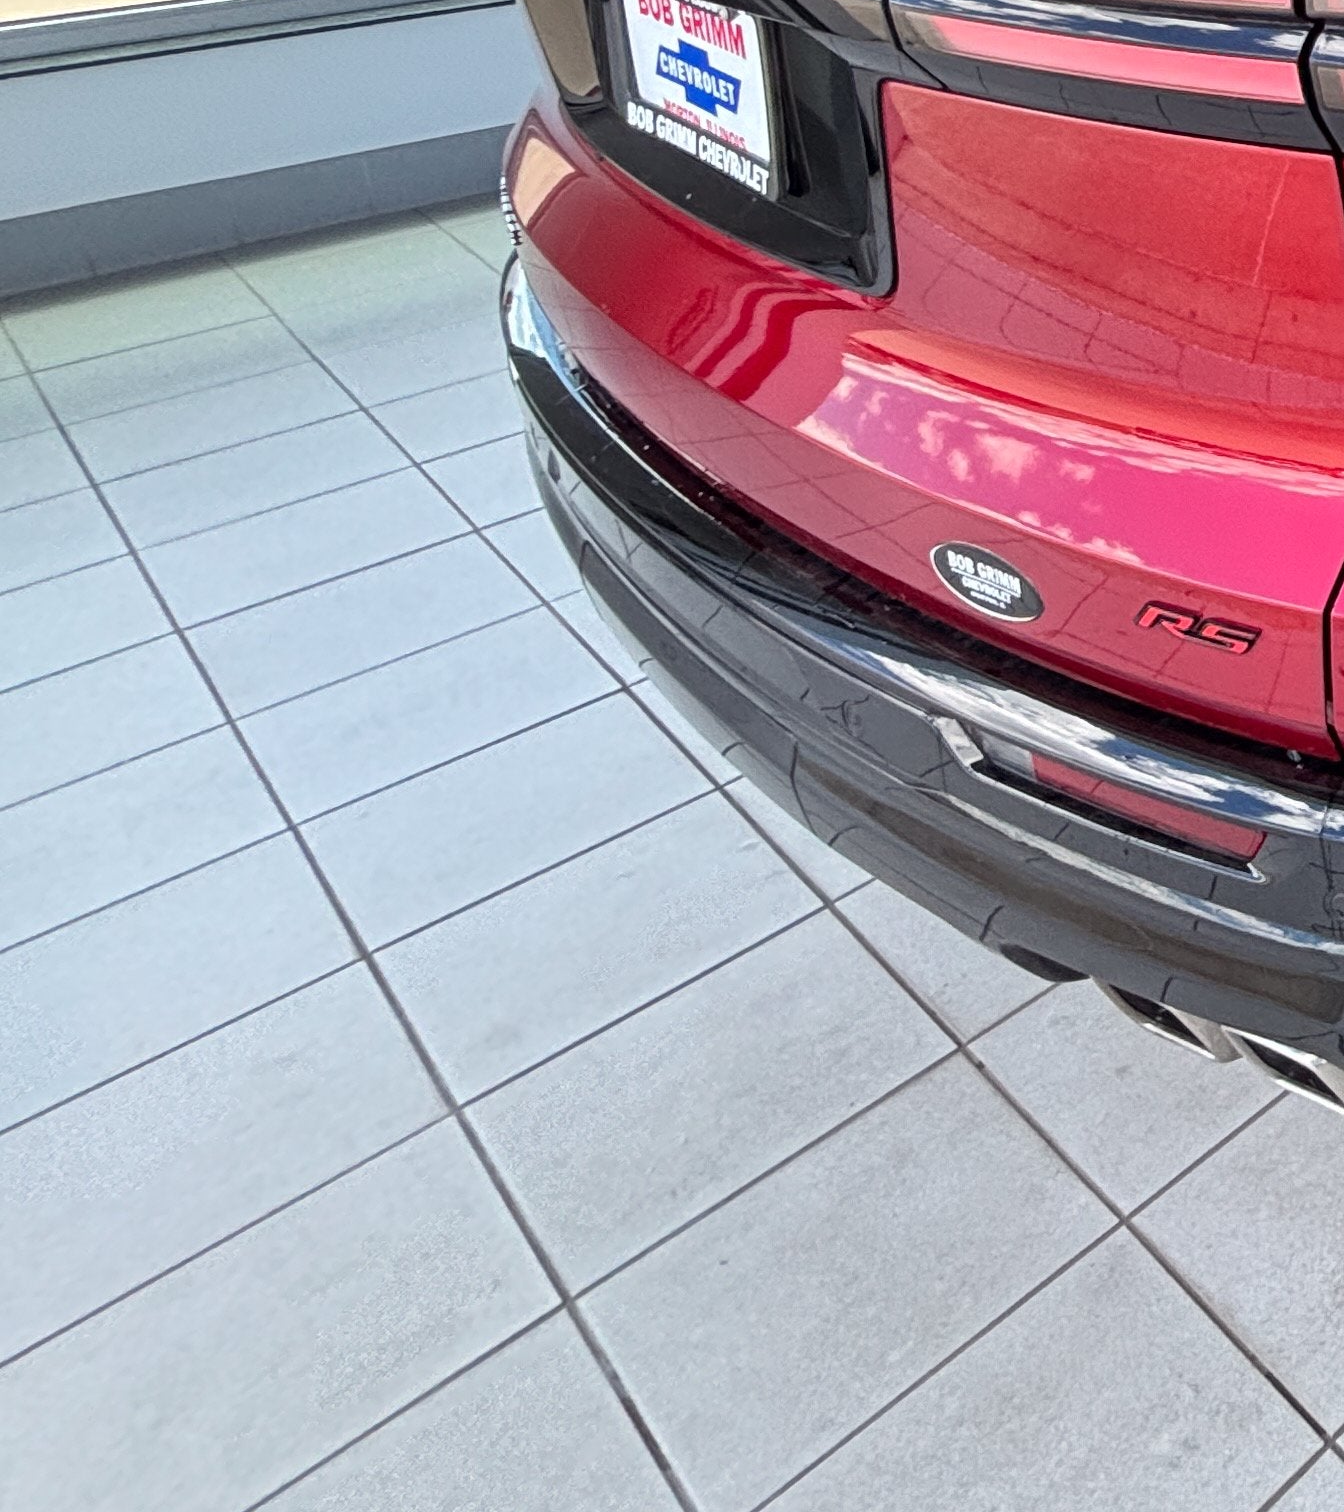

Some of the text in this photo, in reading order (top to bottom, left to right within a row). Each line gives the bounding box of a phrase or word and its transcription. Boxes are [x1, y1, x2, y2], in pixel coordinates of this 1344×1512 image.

[679, 0, 747, 60] GRIMM
[660, 51, 736, 106] CHEVROLET
[627, 101, 770, 196] BOB GRIMM CHEVROLET
[946, 549, 1022, 595] BOB GRIMM
[1133, 600, 1263, 656] RS
